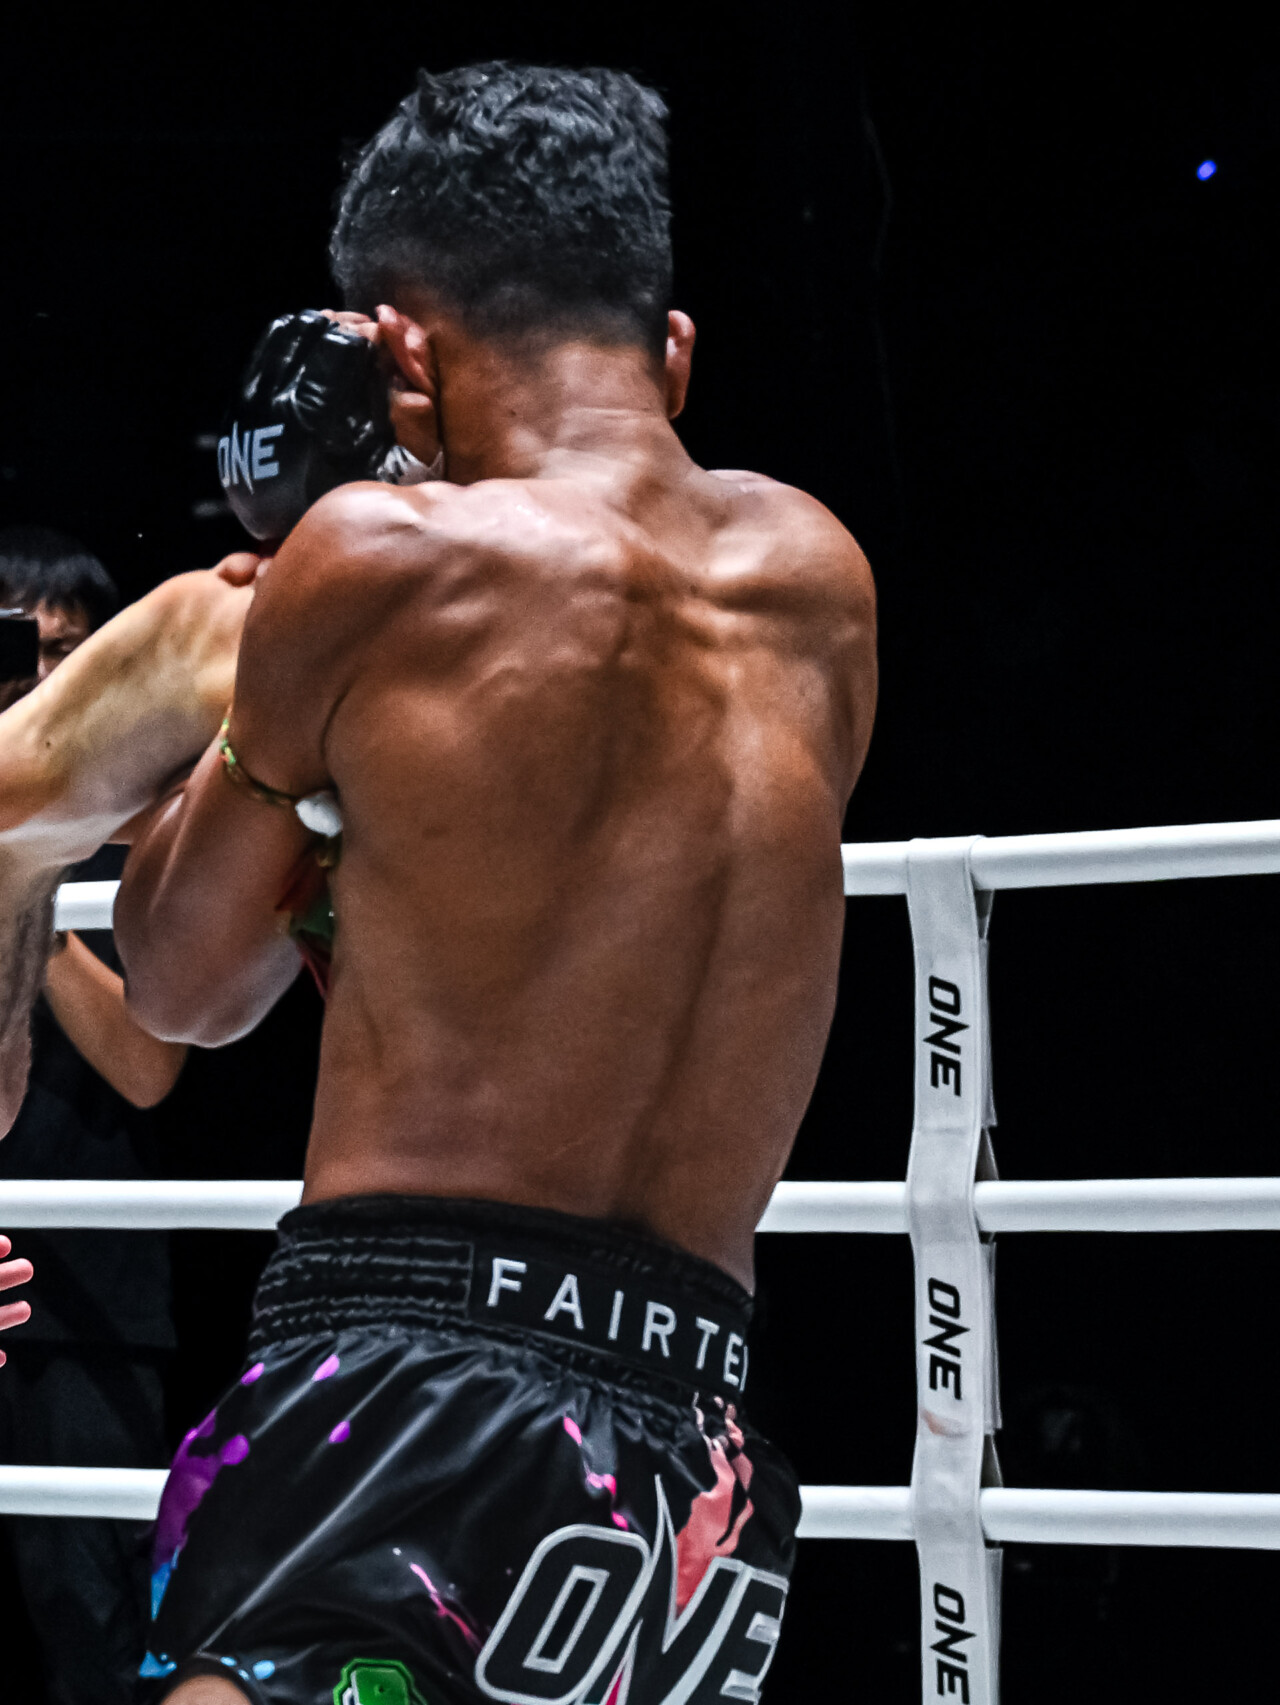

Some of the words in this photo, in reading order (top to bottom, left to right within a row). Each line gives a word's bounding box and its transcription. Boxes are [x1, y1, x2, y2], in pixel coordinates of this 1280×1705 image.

[217, 421, 285, 495] ONE
[922, 975, 970, 1097] ONE
[922, 1277, 971, 1400] ONE
[475, 1474, 790, 1705] ONE
[929, 1582, 977, 1705] ONE
